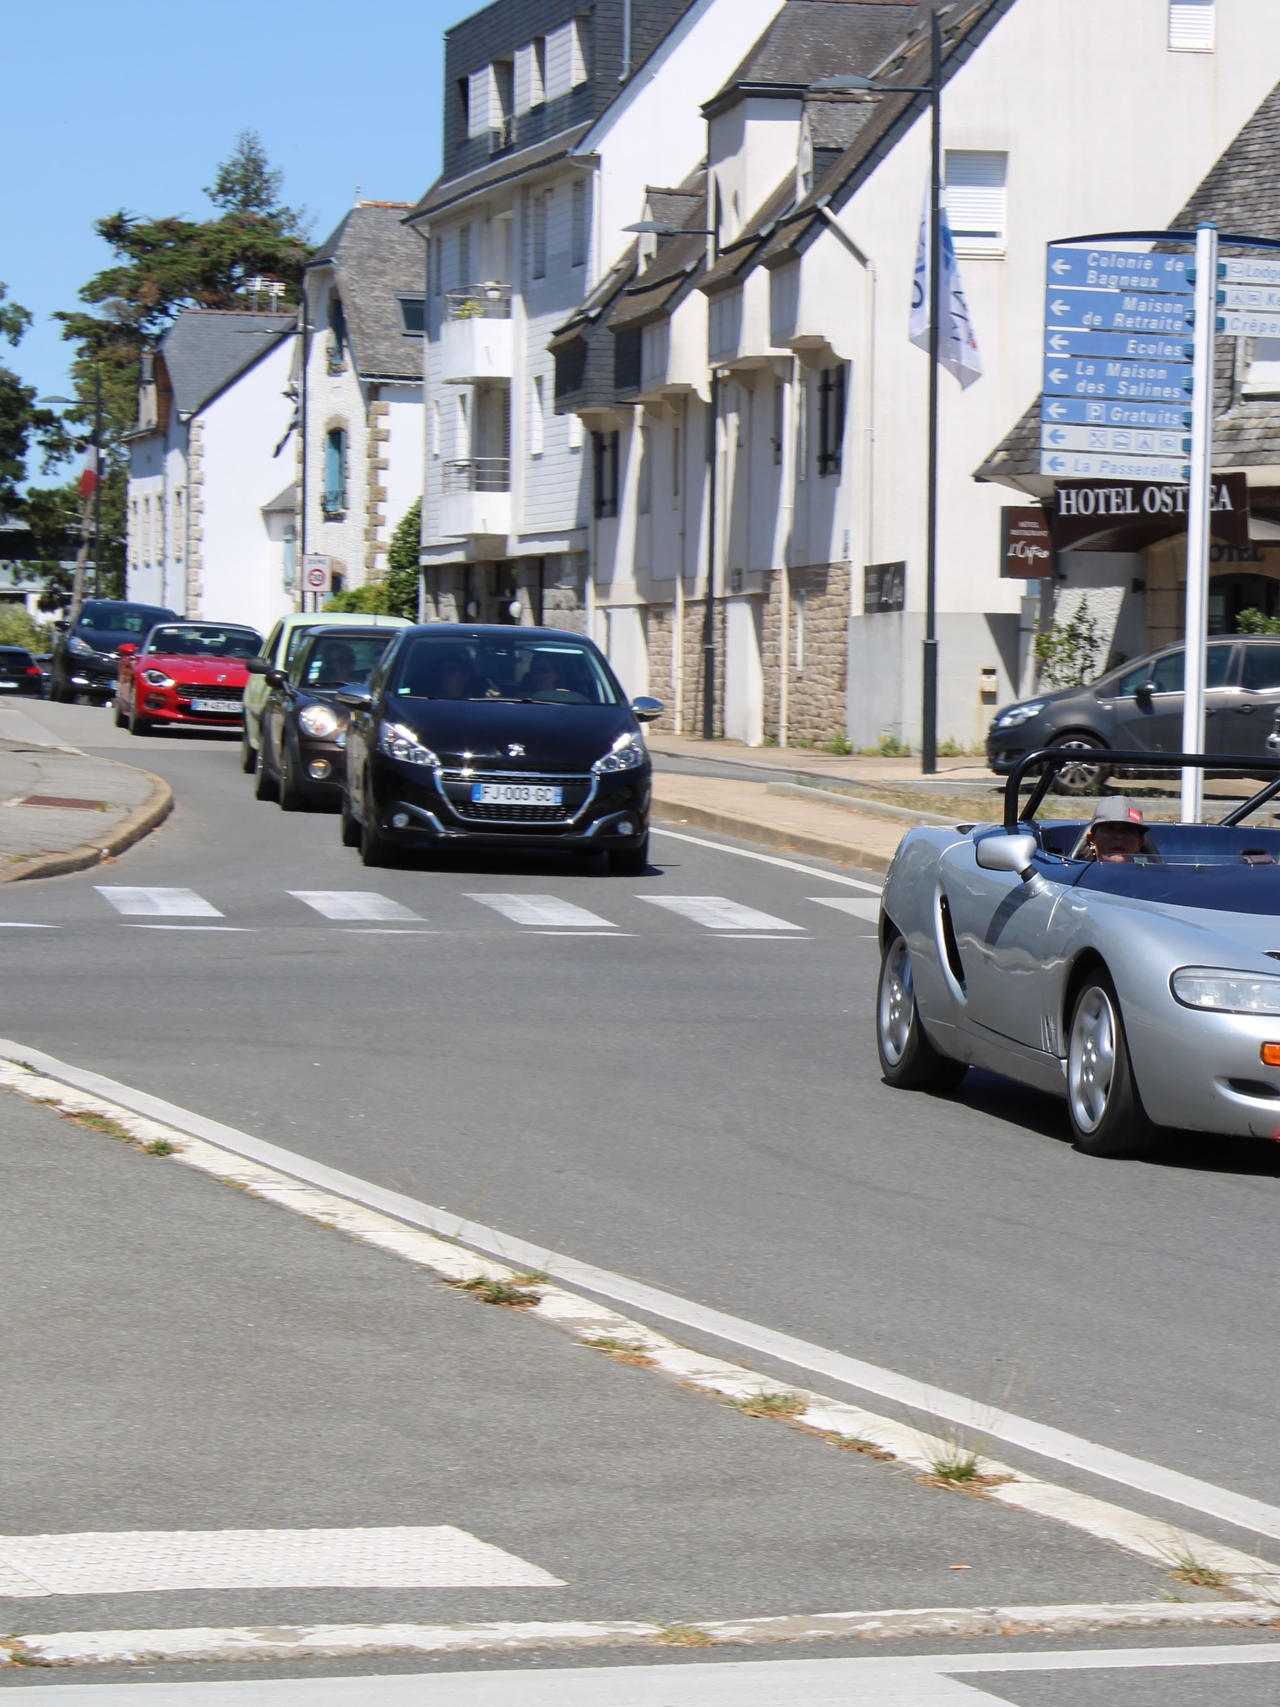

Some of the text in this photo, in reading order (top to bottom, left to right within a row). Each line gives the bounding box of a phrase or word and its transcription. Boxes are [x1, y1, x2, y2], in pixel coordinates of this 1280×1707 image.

[1087, 252, 1185, 272] Colonie de
[1086, 269, 1160, 289] Bagneux
[1122, 296, 1184, 314] Maison
[1082, 311, 1184, 331] de Retraite
[1126, 339, 1183, 357] Ecoles
[1075, 360, 1167, 380] La Maison
[1075, 379, 1181, 398] des Salines
[1110, 406, 1180, 425] Gratuits
[1073, 458, 1179, 478] La Passerelle
[1057, 486, 1140, 516] HOTEL
[483, 785, 553, 802] FJ-003-GC
